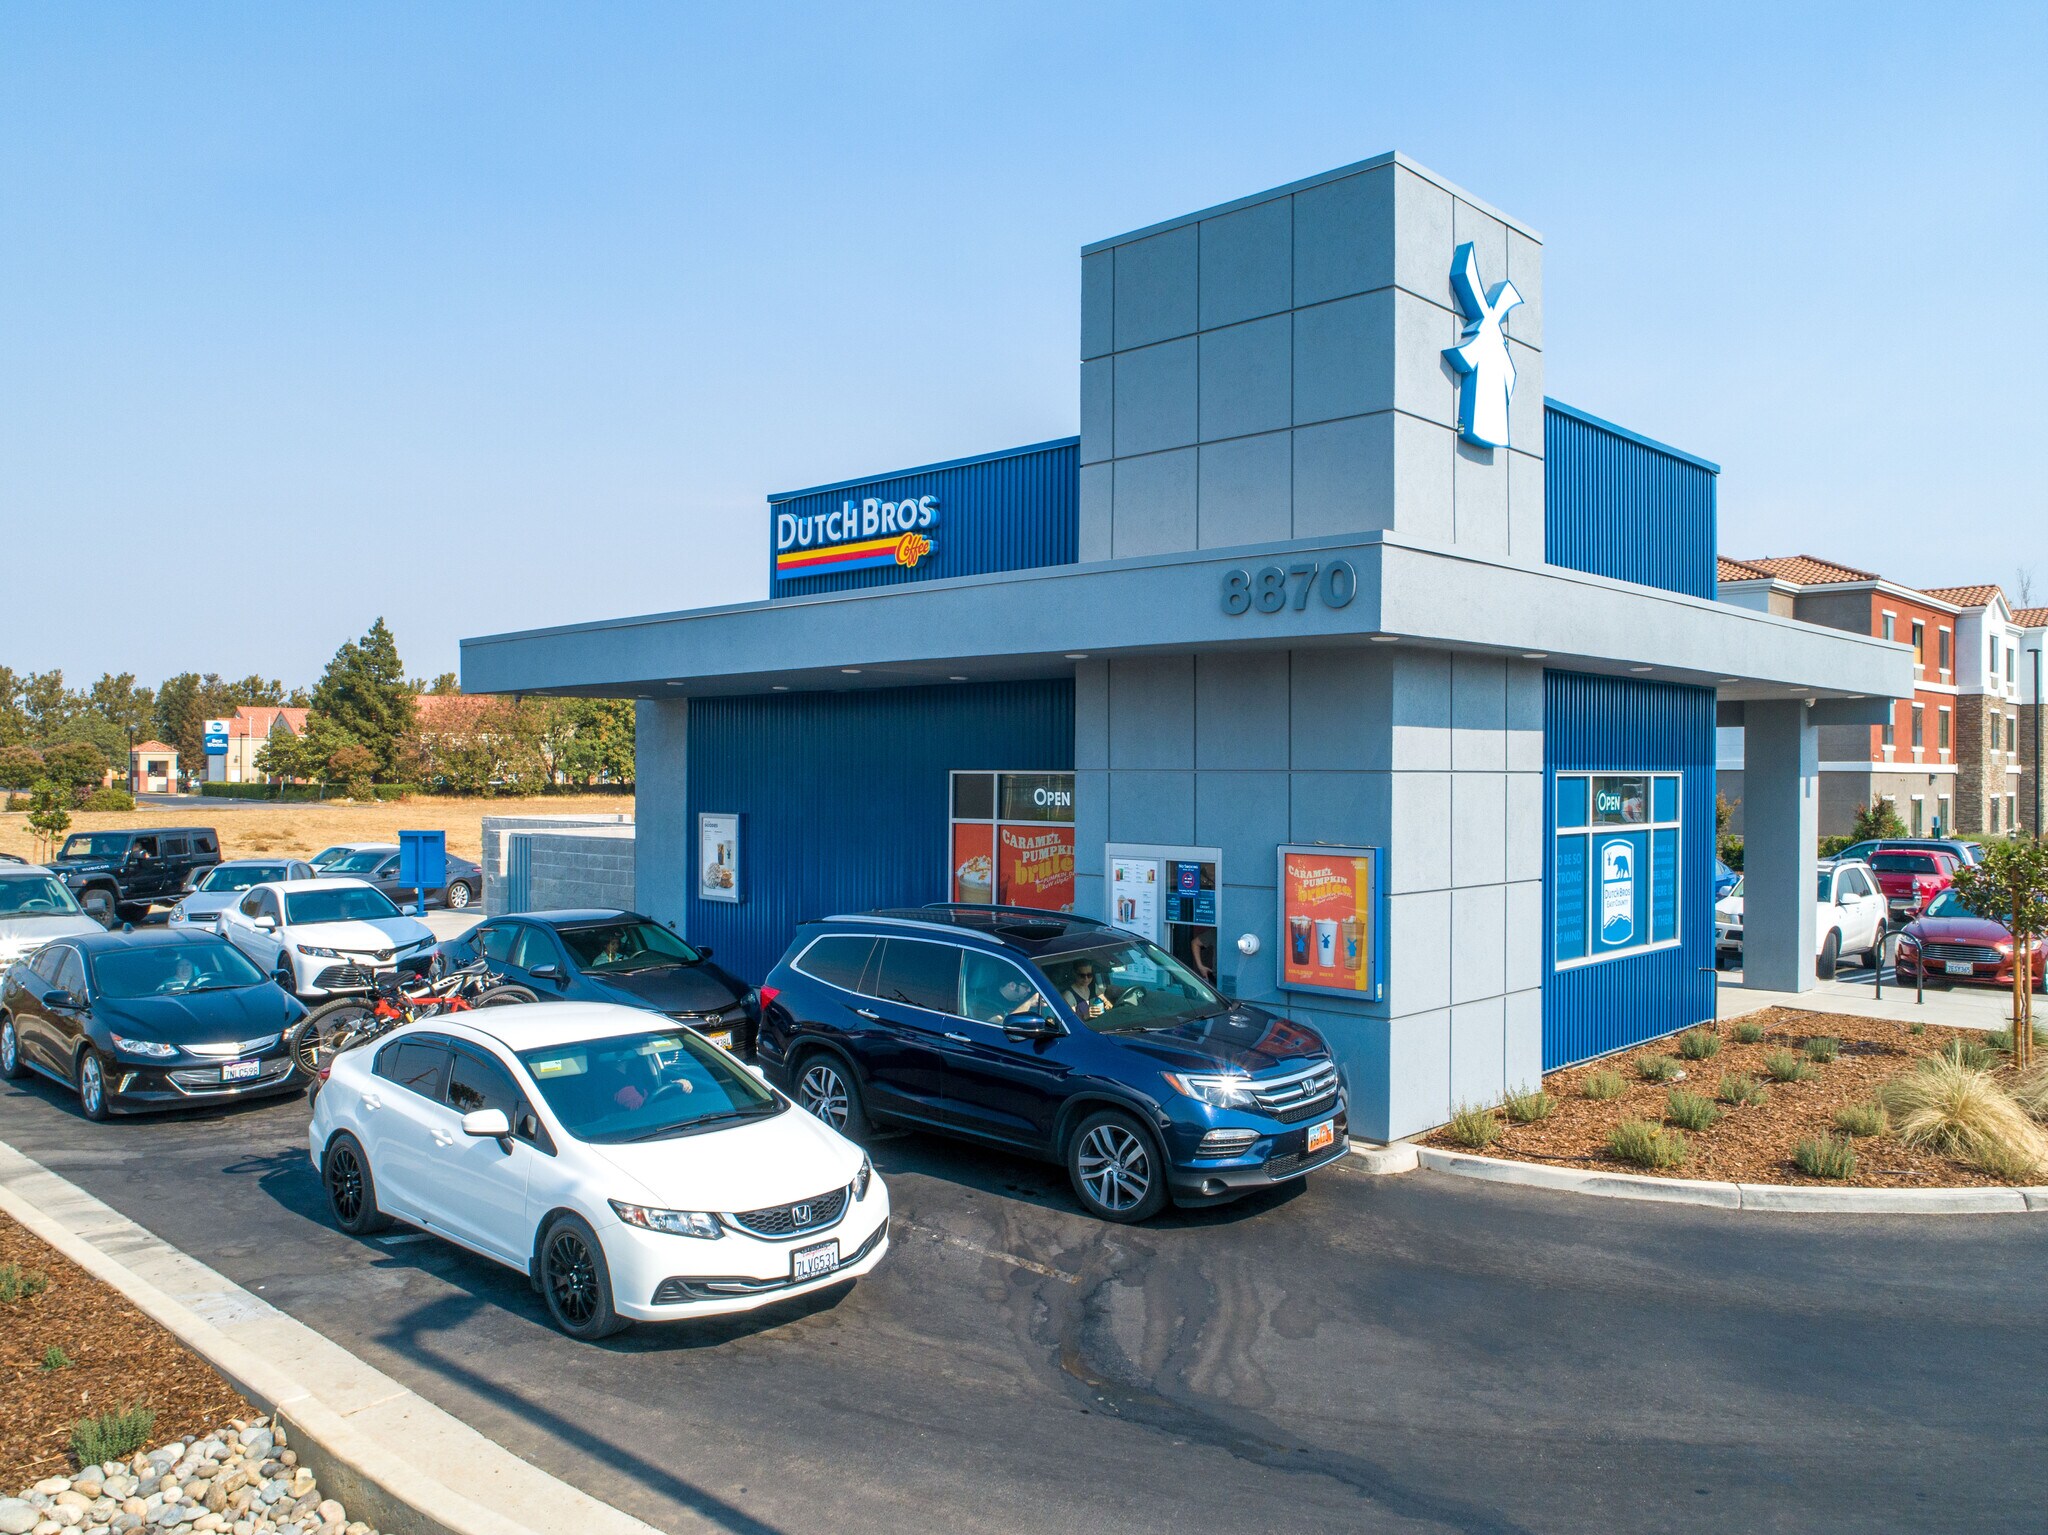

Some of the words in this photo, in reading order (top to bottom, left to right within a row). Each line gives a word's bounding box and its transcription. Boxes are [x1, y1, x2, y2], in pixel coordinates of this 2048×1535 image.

[862, 495, 936, 536] BROS
[895, 532, 931, 568] Coffee
[1221, 560, 1357, 616] 8870
[1033, 787, 1071, 806] OPEN
[1598, 793, 1621, 812] OPEN
[1002, 829, 1061, 849] CARAMEL
[1572, 852, 1582, 865] SO
[1288, 865, 1333, 879] CARAMEL
[1303, 876, 1348, 888] PUMPKIN
[224, 1066, 259, 1080] 7NLC598
[796, 1252, 837, 1277] 7LVG531
